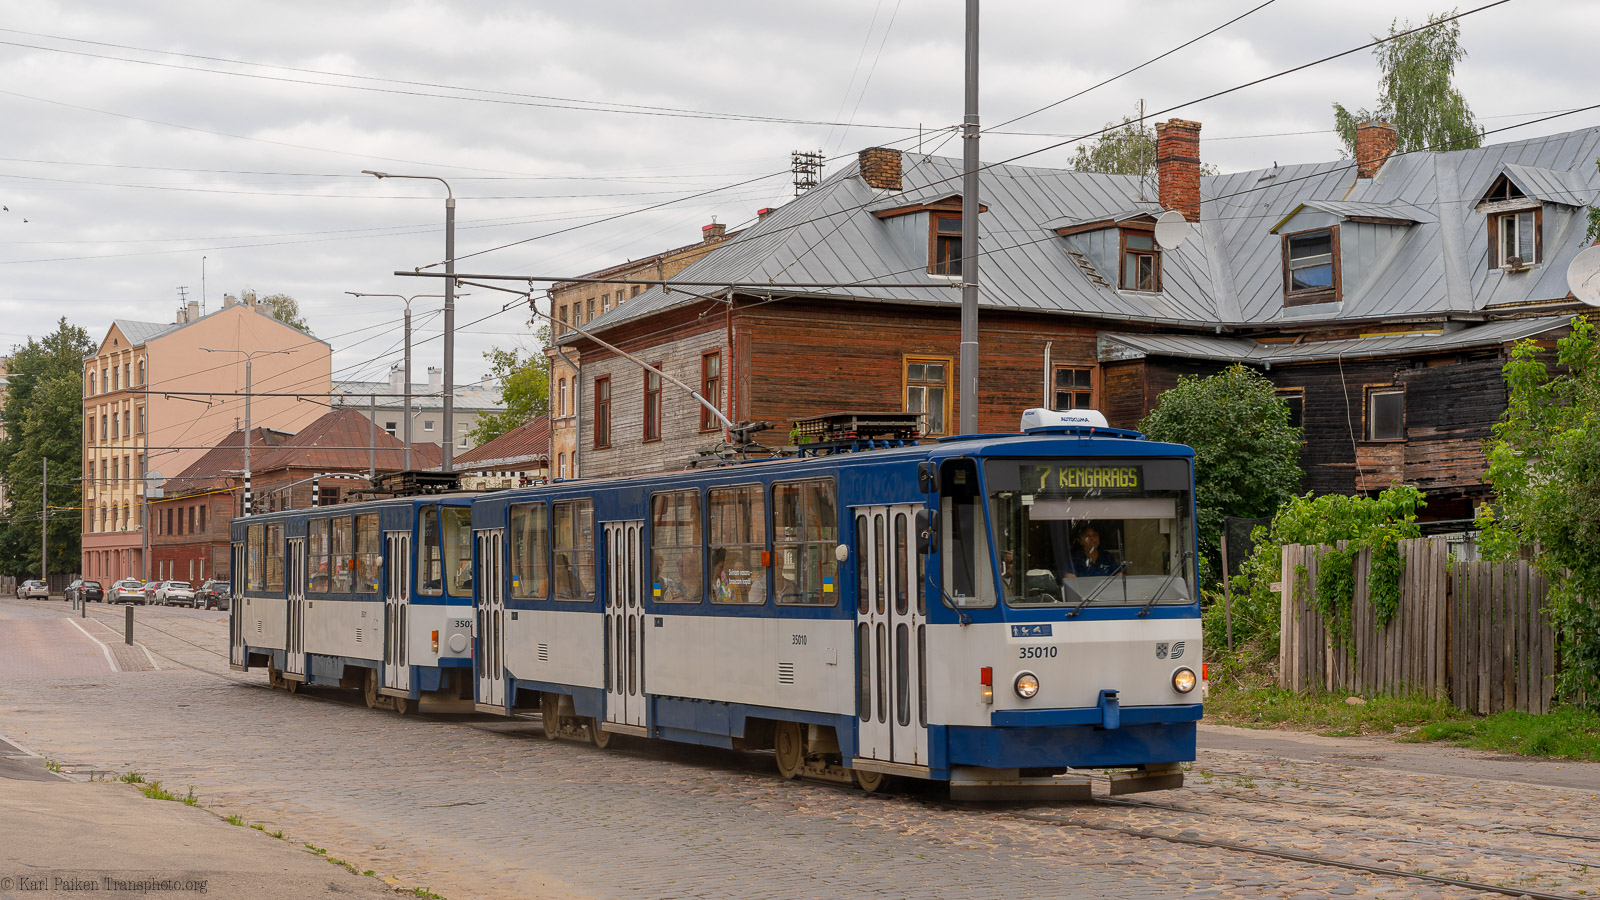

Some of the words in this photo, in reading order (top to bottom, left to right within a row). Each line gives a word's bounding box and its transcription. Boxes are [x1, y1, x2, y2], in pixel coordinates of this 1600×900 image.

[1036, 465, 1051, 489] 7
[1059, 467, 1137, 488] ĶENGARAGS
[792, 634, 807, 646] 35010
[1019, 646, 1058, 659] 35010
